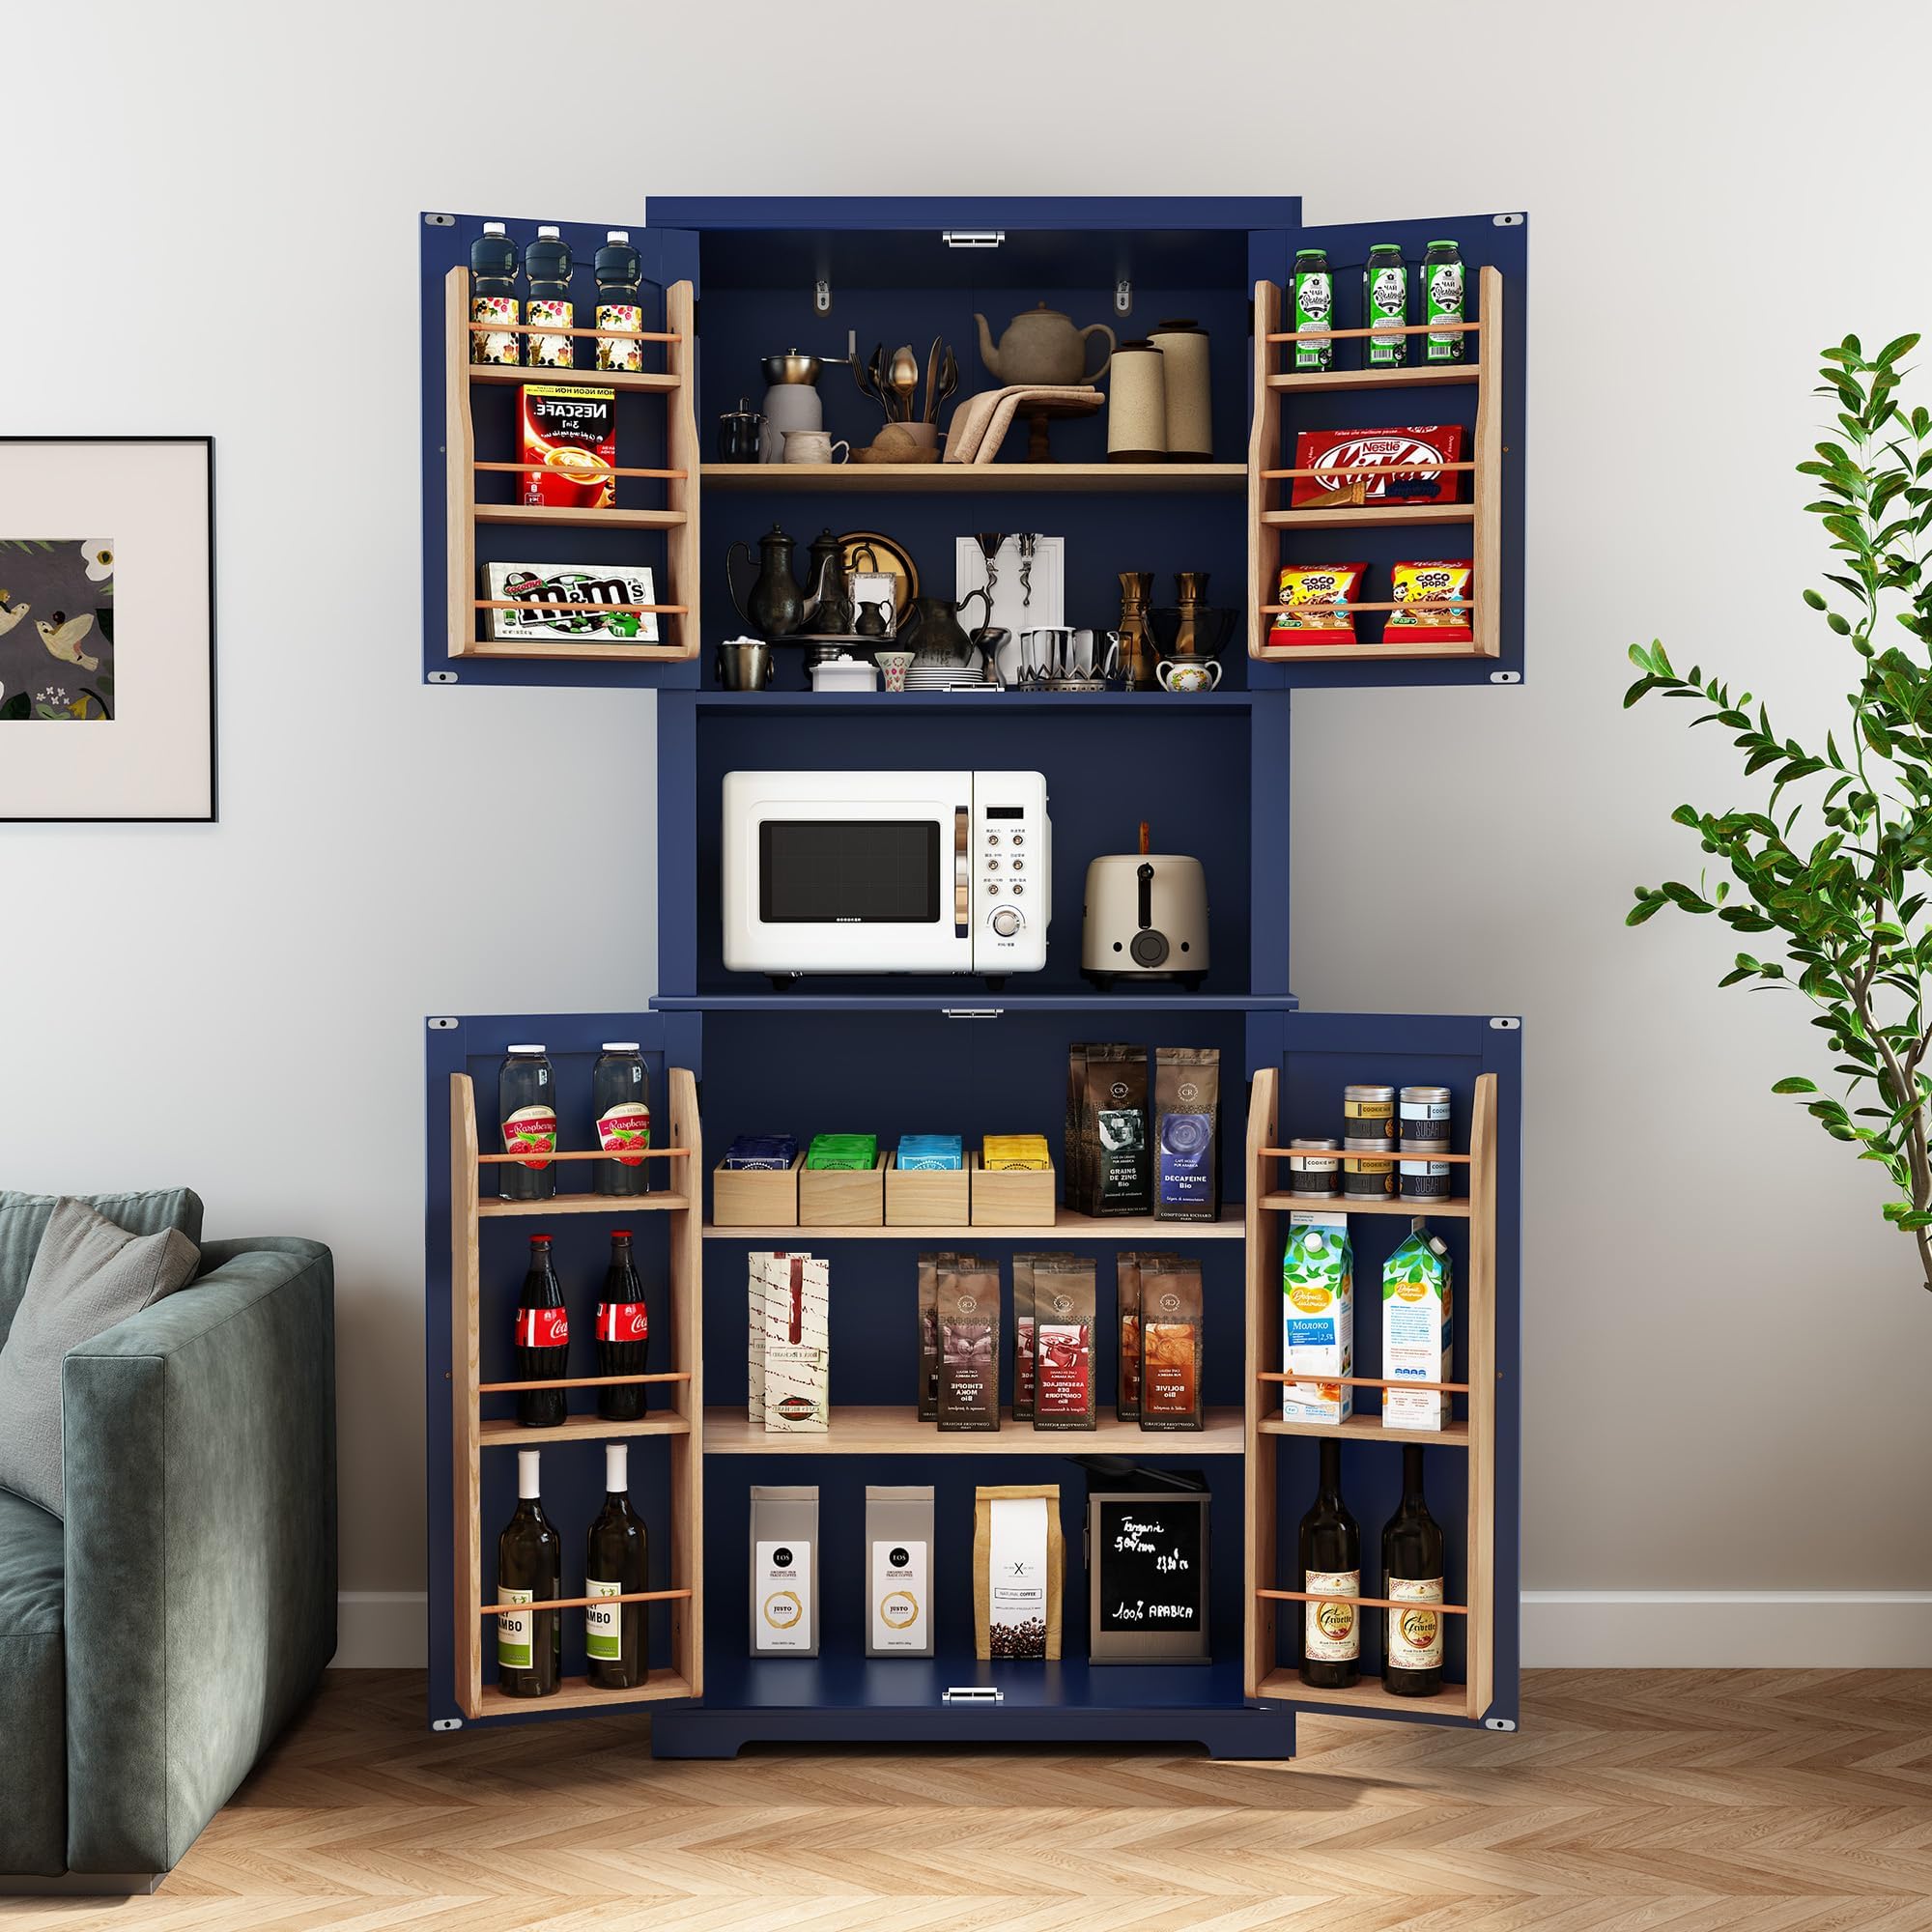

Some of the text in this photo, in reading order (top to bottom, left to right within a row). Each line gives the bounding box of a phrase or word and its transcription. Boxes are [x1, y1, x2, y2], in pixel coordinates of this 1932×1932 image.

[1307, 582, 1332, 592] pops
[1421, 580, 1447, 589] pops
[514, 1122, 553, 1134] Raspberry
[610, 1119, 647, 1132] Raspberry
[1415, 1121, 1440, 1137] SUGAR
[1415, 1177, 1439, 1193] SUGAR
[1293, 1321, 1329, 1330] Молоко
[1149, 1605, 1194, 1618] ARABICA
